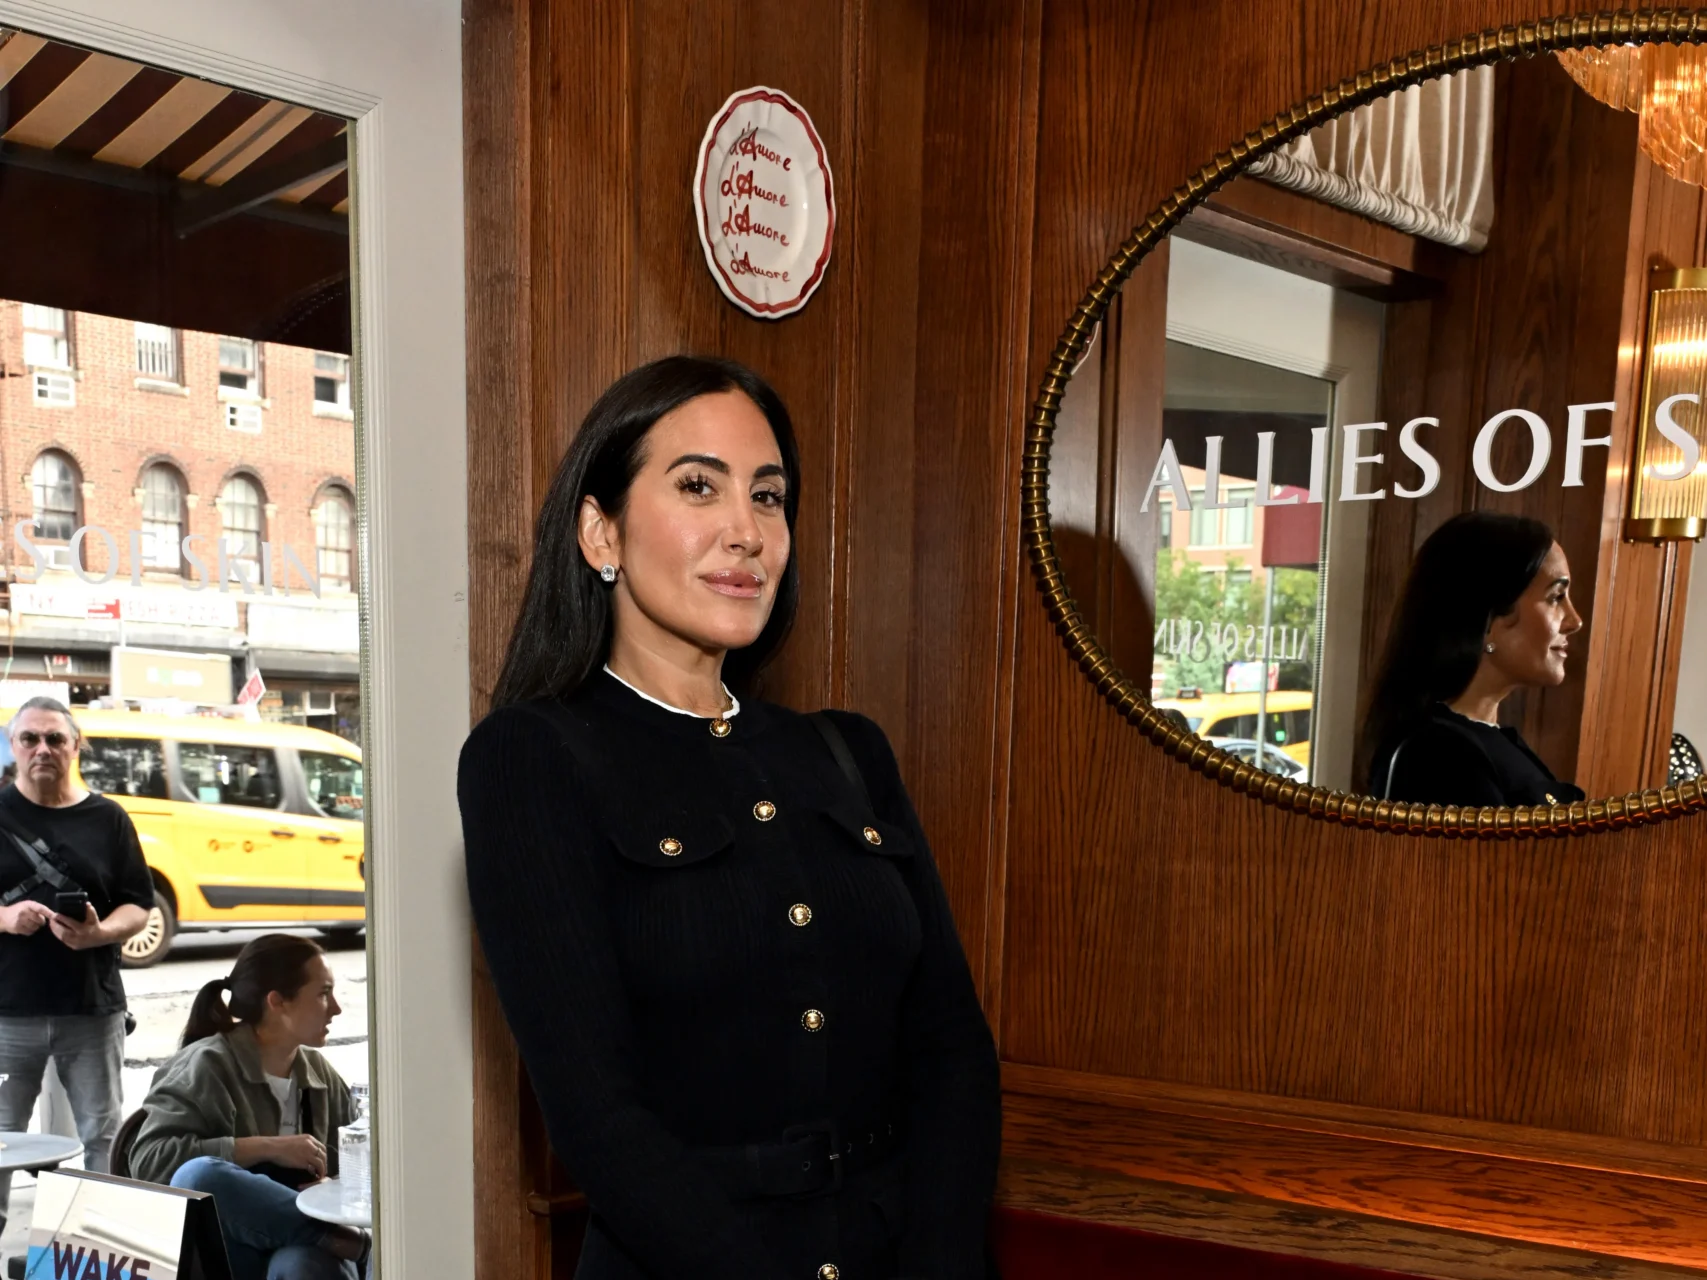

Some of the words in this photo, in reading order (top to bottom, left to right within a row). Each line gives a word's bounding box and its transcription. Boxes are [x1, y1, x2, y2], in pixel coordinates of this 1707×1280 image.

[1139, 416, 1441, 513] ALLIES
[1472, 401, 1617, 493] OF
[69, 525, 158, 587] OF
[181, 534, 322, 600] SKIN
